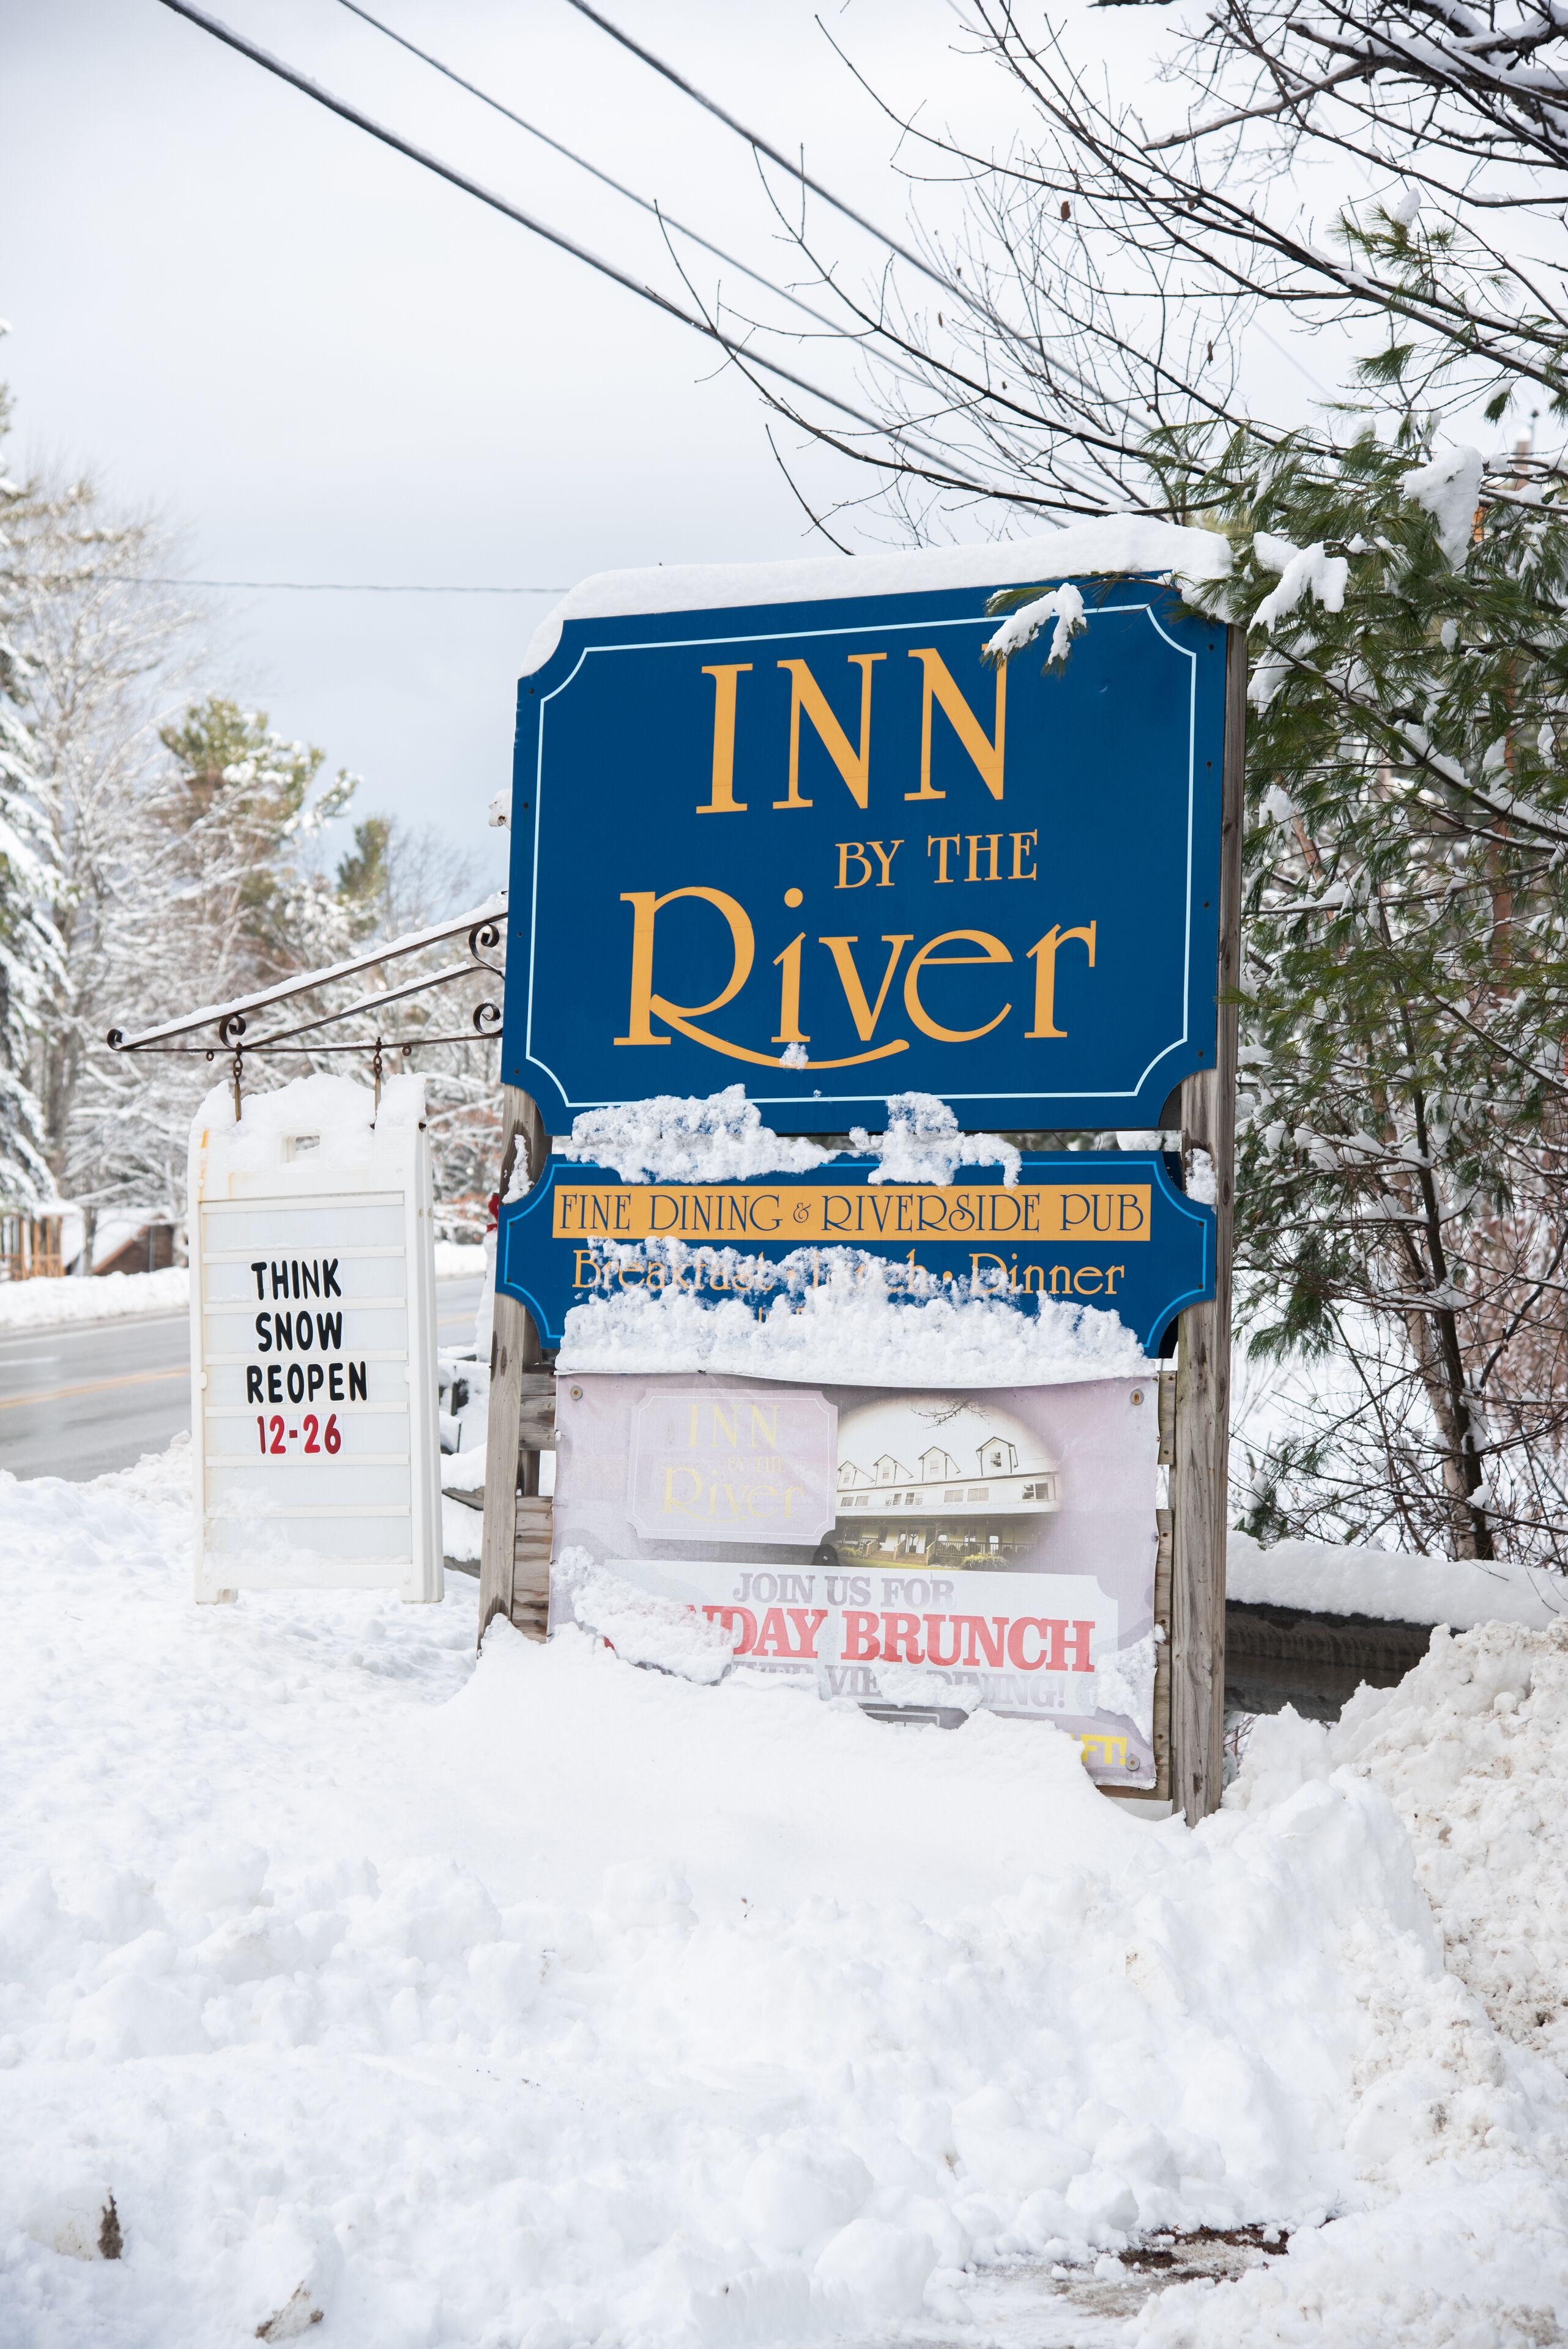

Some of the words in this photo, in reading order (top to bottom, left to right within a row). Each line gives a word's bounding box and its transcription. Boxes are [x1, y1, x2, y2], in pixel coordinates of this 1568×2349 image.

[696, 642, 1008, 814] INN
[834, 839, 904, 889] BY
[927, 829, 1038, 883] THE
[613, 886, 1097, 1069] River
[560, 1193, 631, 1230] FINE
[650, 1193, 782, 1232] DINING
[793, 1201, 811, 1223] &
[822, 1193, 1041, 1232] RIVERSIDE
[1060, 1193, 1145, 1232] PUB
[250, 1258, 343, 1301] THINK
[968, 1252, 1125, 1296] Dinner
[255, 1310, 343, 1353] SNOW
[246, 1360, 368, 1405] REOPEN
[256, 1413, 342, 1455] 12-26
[686, 1404, 781, 1449] INN
[660, 1466, 803, 1523] River
[732, 1572, 816, 1604] JOIN
[824, 1575, 871, 1606] US
[881, 1577, 957, 1609] FOR
[841, 1611, 1095, 1673] BRUNCH
[825, 1664, 882, 1698] VIE
